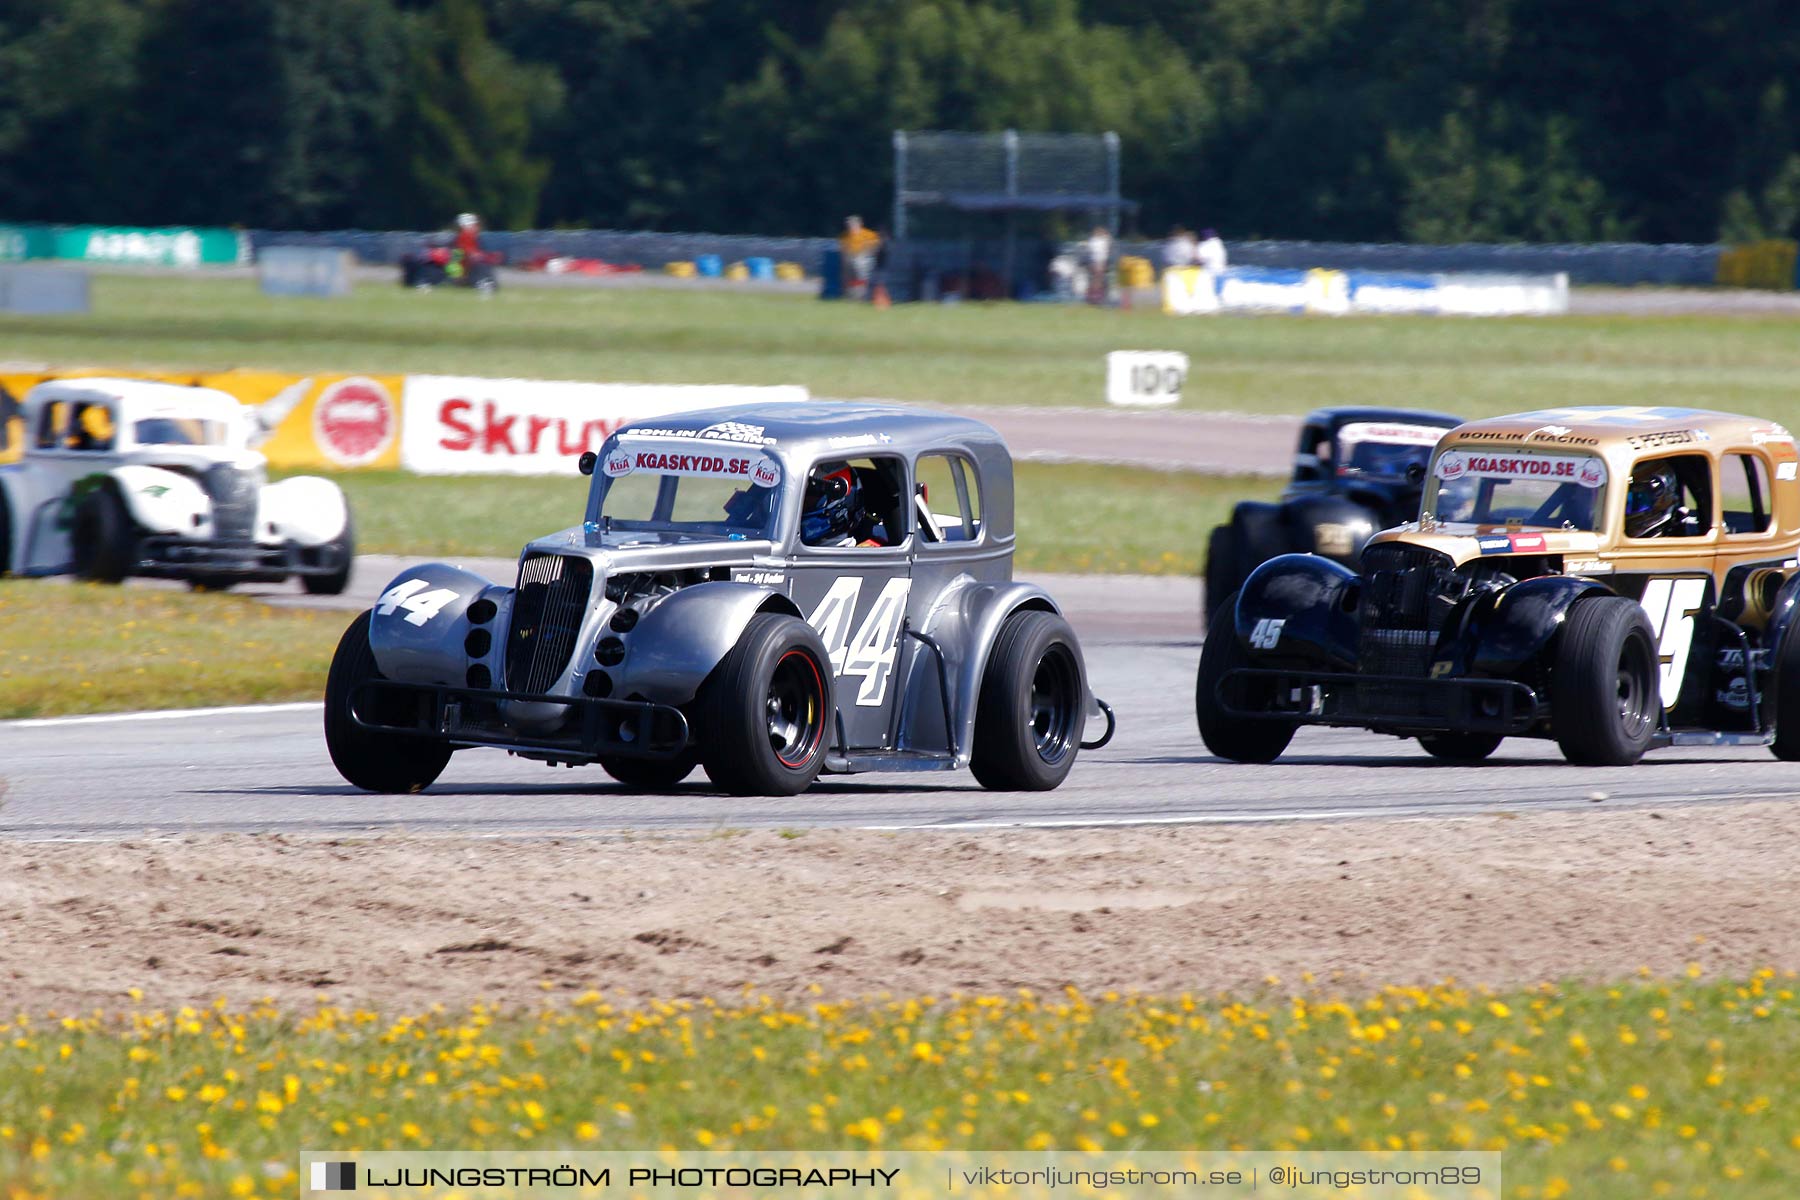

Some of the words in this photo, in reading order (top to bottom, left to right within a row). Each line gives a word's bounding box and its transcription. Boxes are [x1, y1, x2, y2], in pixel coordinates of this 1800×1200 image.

[1130, 363, 1182, 396] 100
[627, 428, 696, 438] BOHLIN
[706, 431, 777, 446] RACING
[1459, 432, 1524, 441] BOHLIN
[1534, 433, 1599, 446] RACING
[609, 458, 630, 472] KGA
[635, 453, 751, 475] KGASKYDD.SE
[1467, 457, 1576, 477] KGASKYDD.SE
[755, 467, 775, 483] KGA
[377, 578, 460, 627] 44
[806, 576, 912, 706] 44
[1250, 618, 1286, 649] 45
